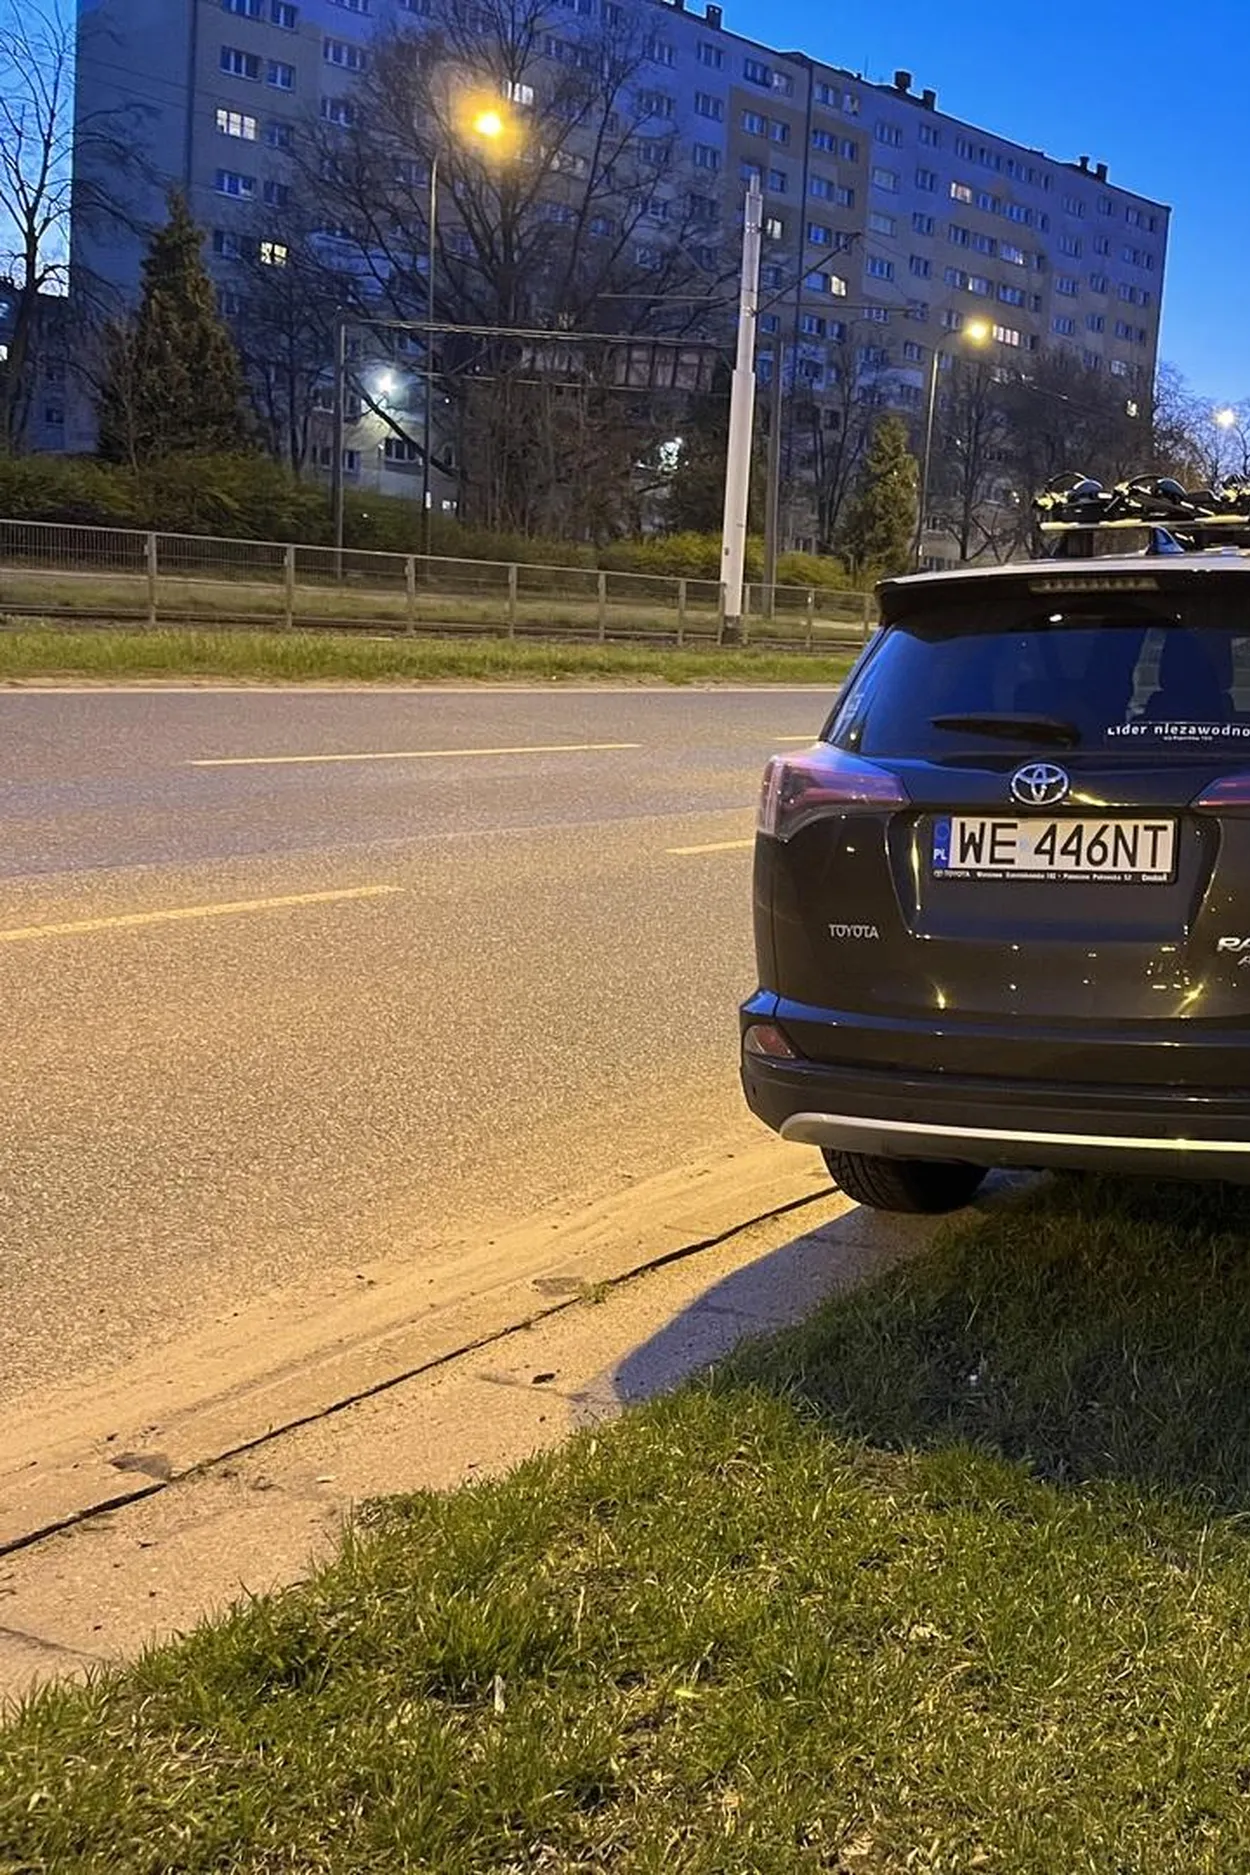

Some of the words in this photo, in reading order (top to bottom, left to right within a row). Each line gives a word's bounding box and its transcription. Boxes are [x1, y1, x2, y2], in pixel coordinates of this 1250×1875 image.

[959, 821, 1018, 865] WE
[1033, 823, 1168, 869] 446NT
[933, 848, 948, 861] PL
[828, 924, 880, 940] TOYOTA
